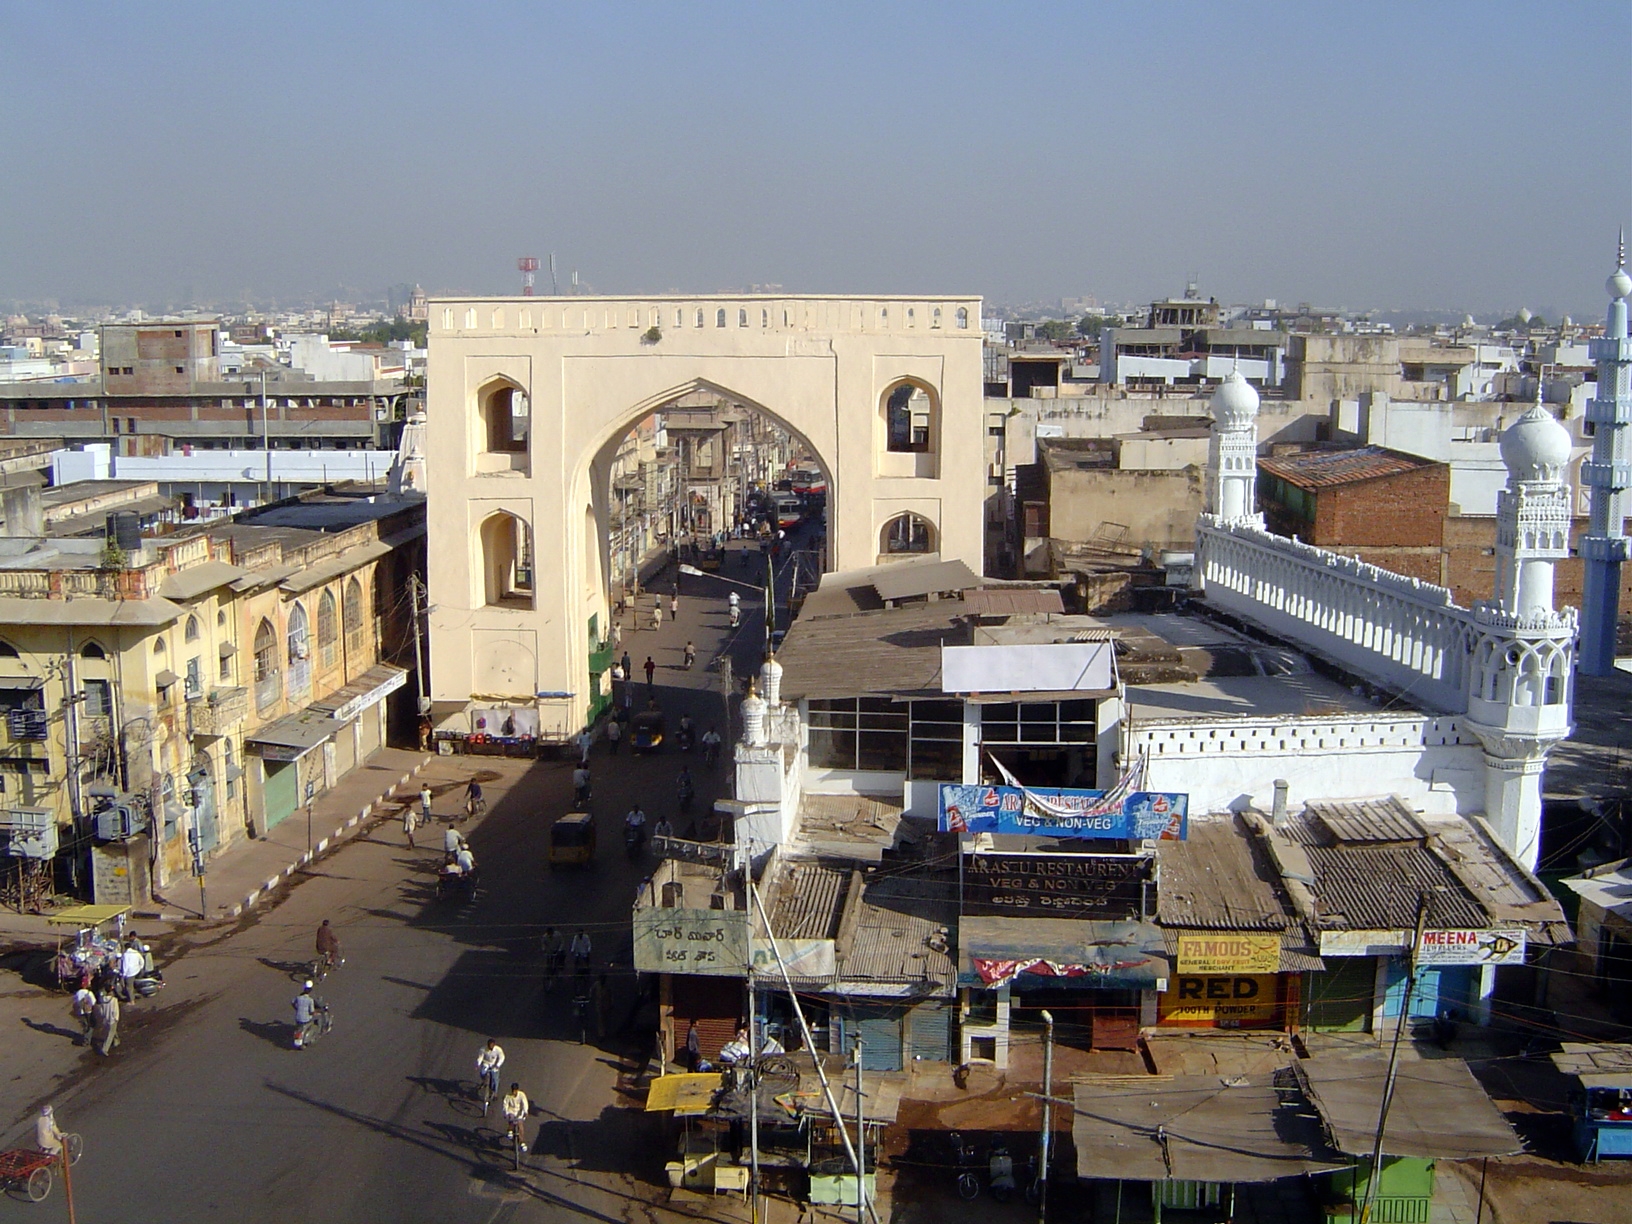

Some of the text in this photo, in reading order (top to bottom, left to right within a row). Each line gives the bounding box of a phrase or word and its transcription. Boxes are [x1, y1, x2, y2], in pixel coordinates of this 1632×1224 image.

[1016, 815, 1041, 827] VEG
[1044, 818, 1052, 828] &
[1055, 818, 1111, 830] NON-VEG
[990, 878, 1116, 891] VEG & NON VEG
[1423, 931, 1478, 945] MEENA
[1183, 941, 1252, 957] FAMOUS
[1422, 944, 1467, 952] JEWELLERS
[1178, 977, 1259, 999] RED
[1178, 1005, 1256, 1014] TOOTH POWDER
